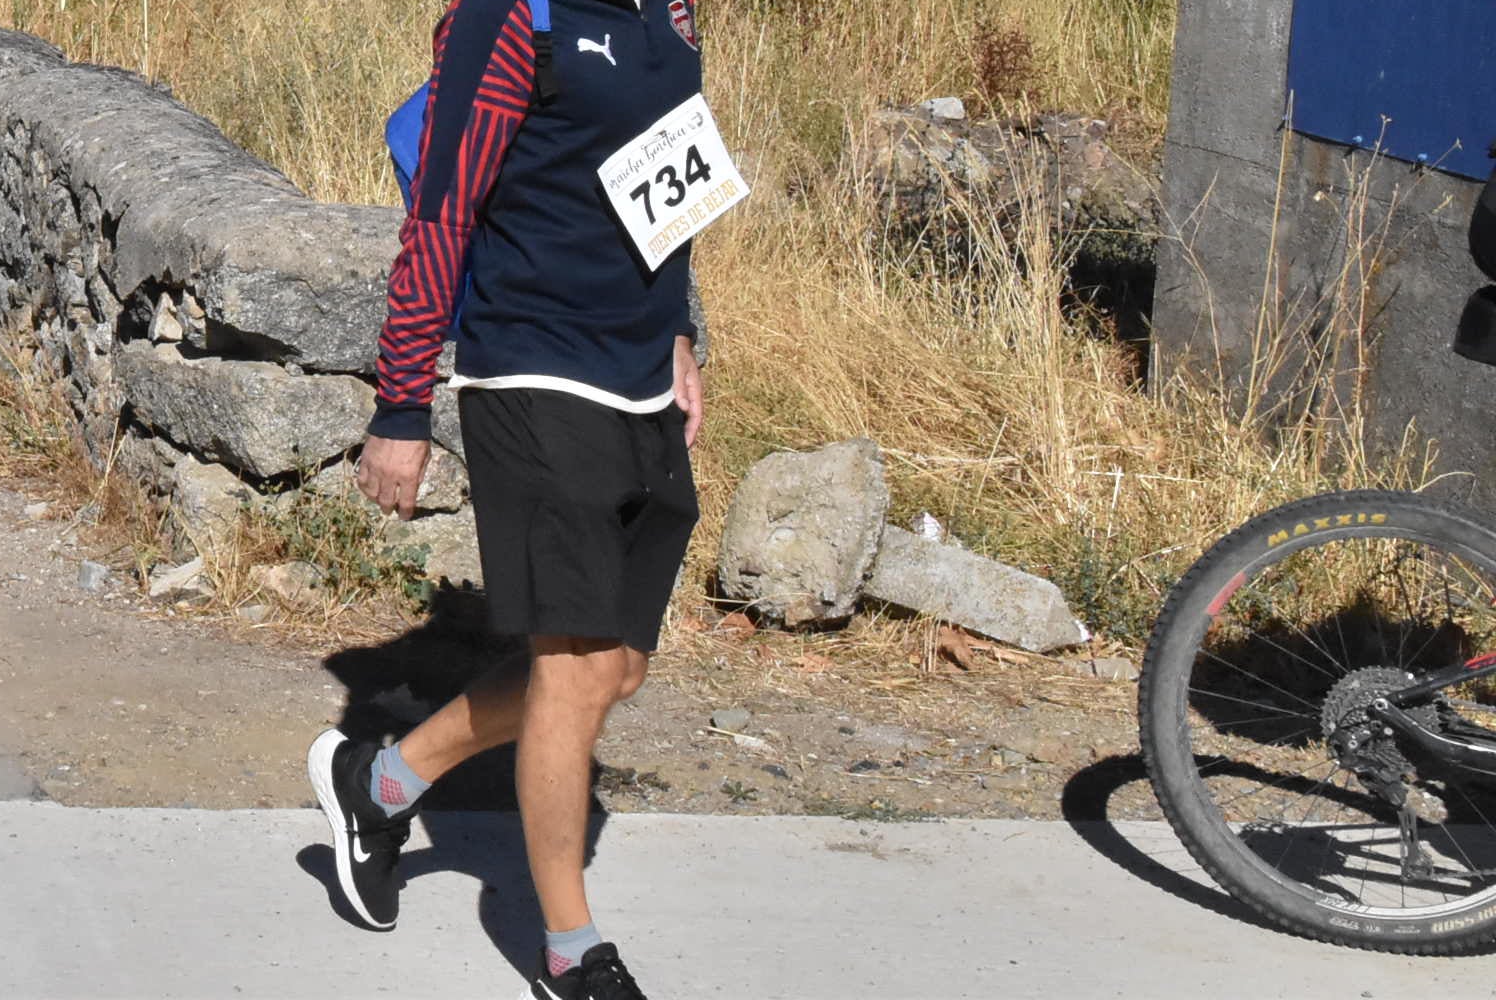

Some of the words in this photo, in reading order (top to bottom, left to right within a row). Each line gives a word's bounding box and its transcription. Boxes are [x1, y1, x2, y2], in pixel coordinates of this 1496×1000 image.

[629, 144, 712, 226] 734
[647, 215, 691, 259] FUENTES
[687, 202, 707, 225] DE
[1266, 512, 1387, 548] MAXXIS
